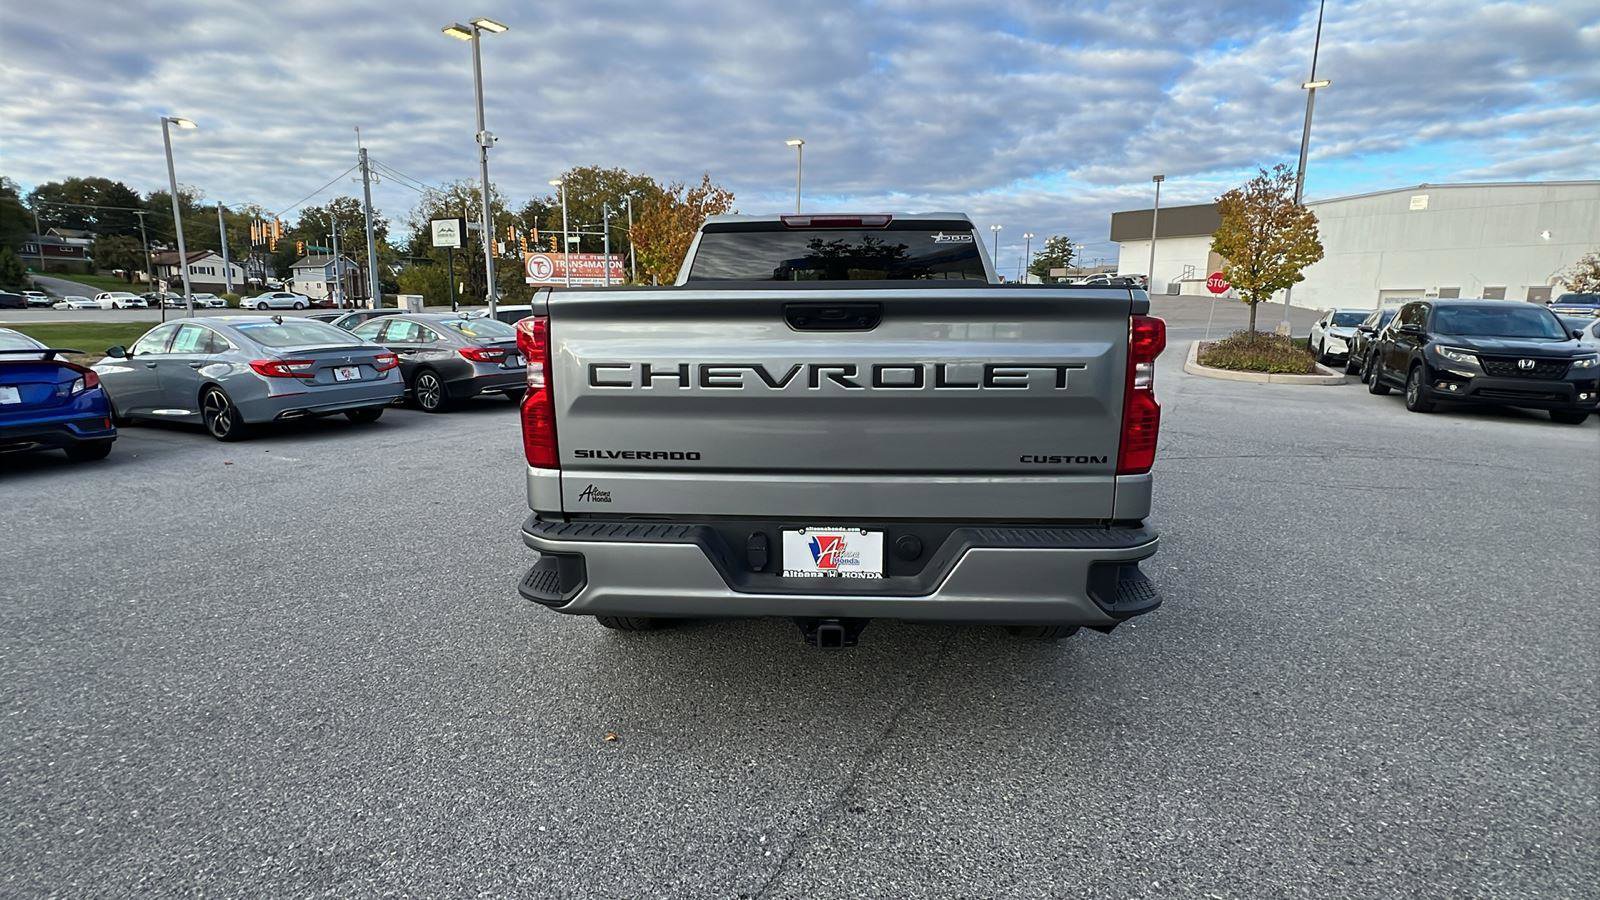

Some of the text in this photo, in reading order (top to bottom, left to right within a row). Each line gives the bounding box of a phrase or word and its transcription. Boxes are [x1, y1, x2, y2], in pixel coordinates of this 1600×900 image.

[555, 260, 623, 268] TRNS4MATON
[1207, 278, 1230, 288] STOP
[588, 362, 1088, 390] CHEVROLET
[574, 449, 701, 460] SILVERADO
[1020, 455, 1108, 464] CUSTOM
[833, 556, 860, 565] Honda
[782, 569, 824, 578] Altoona
[841, 570, 883, 579] HONDA
